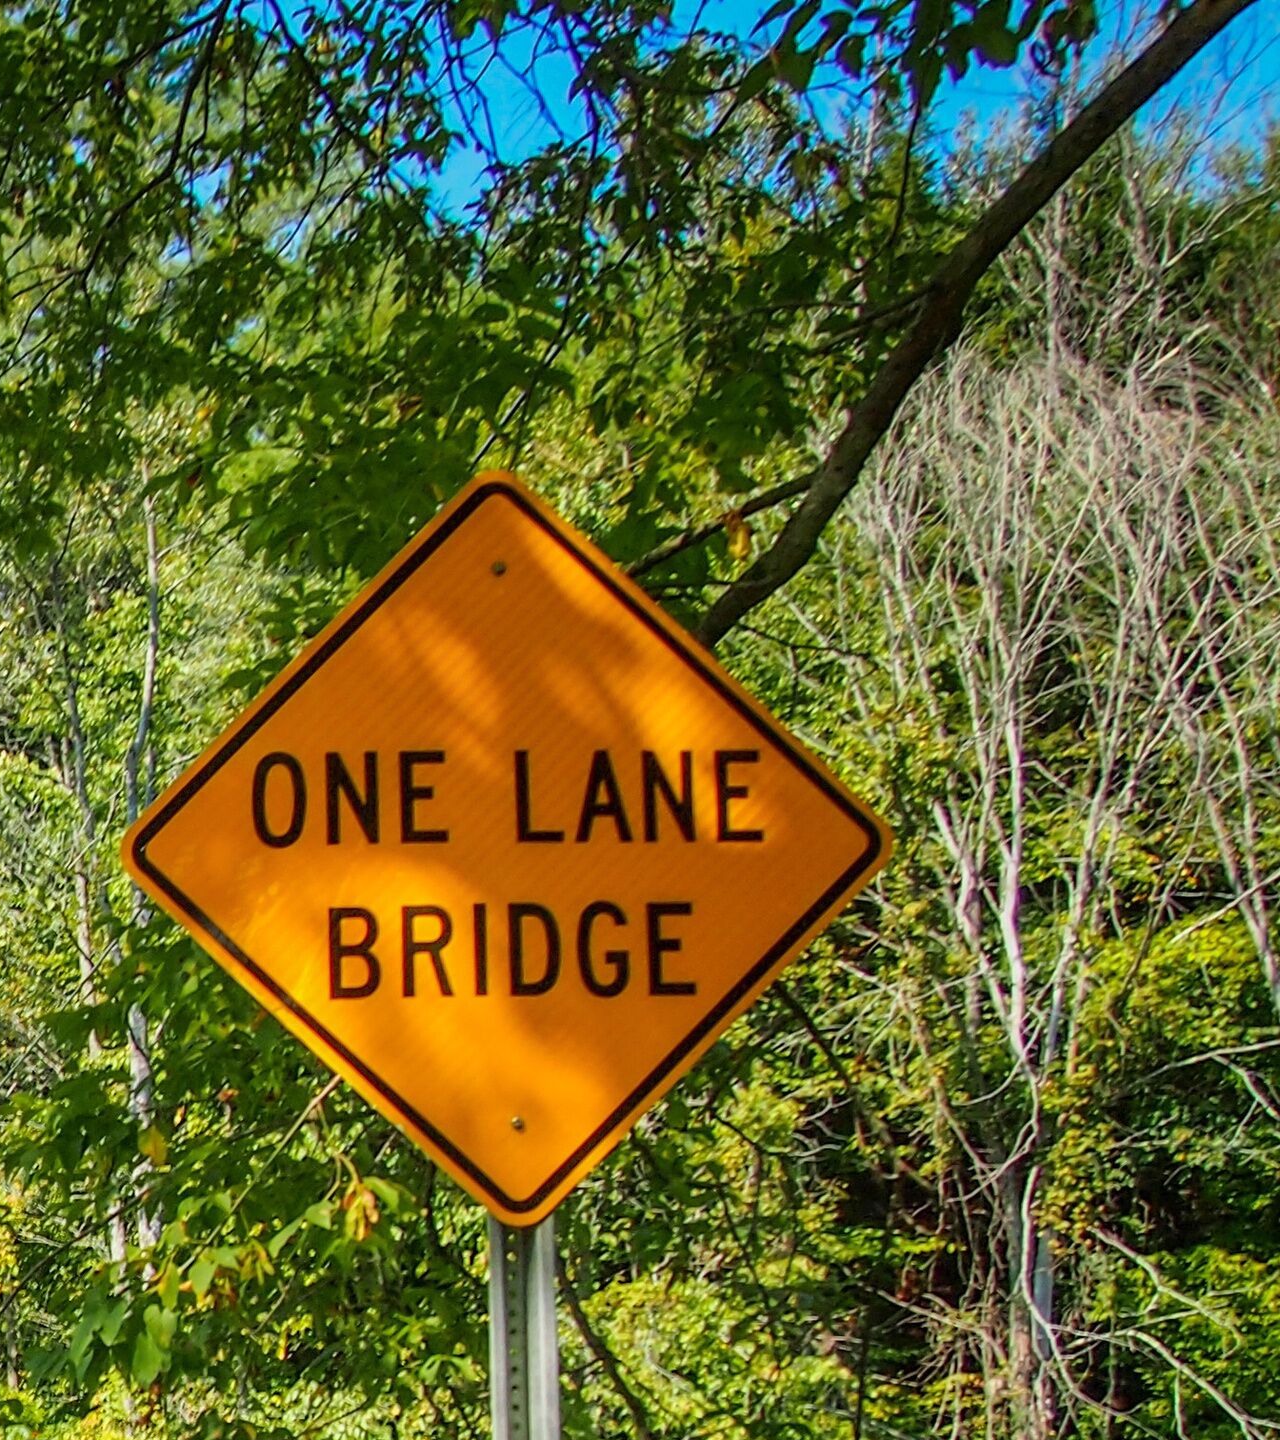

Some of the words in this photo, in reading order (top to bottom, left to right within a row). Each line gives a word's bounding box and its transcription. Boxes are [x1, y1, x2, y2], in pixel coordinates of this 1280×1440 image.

[251, 750, 450, 849] ONE
[514, 748, 766, 845] LANE
[328, 901, 698, 1000] BRIDGE
